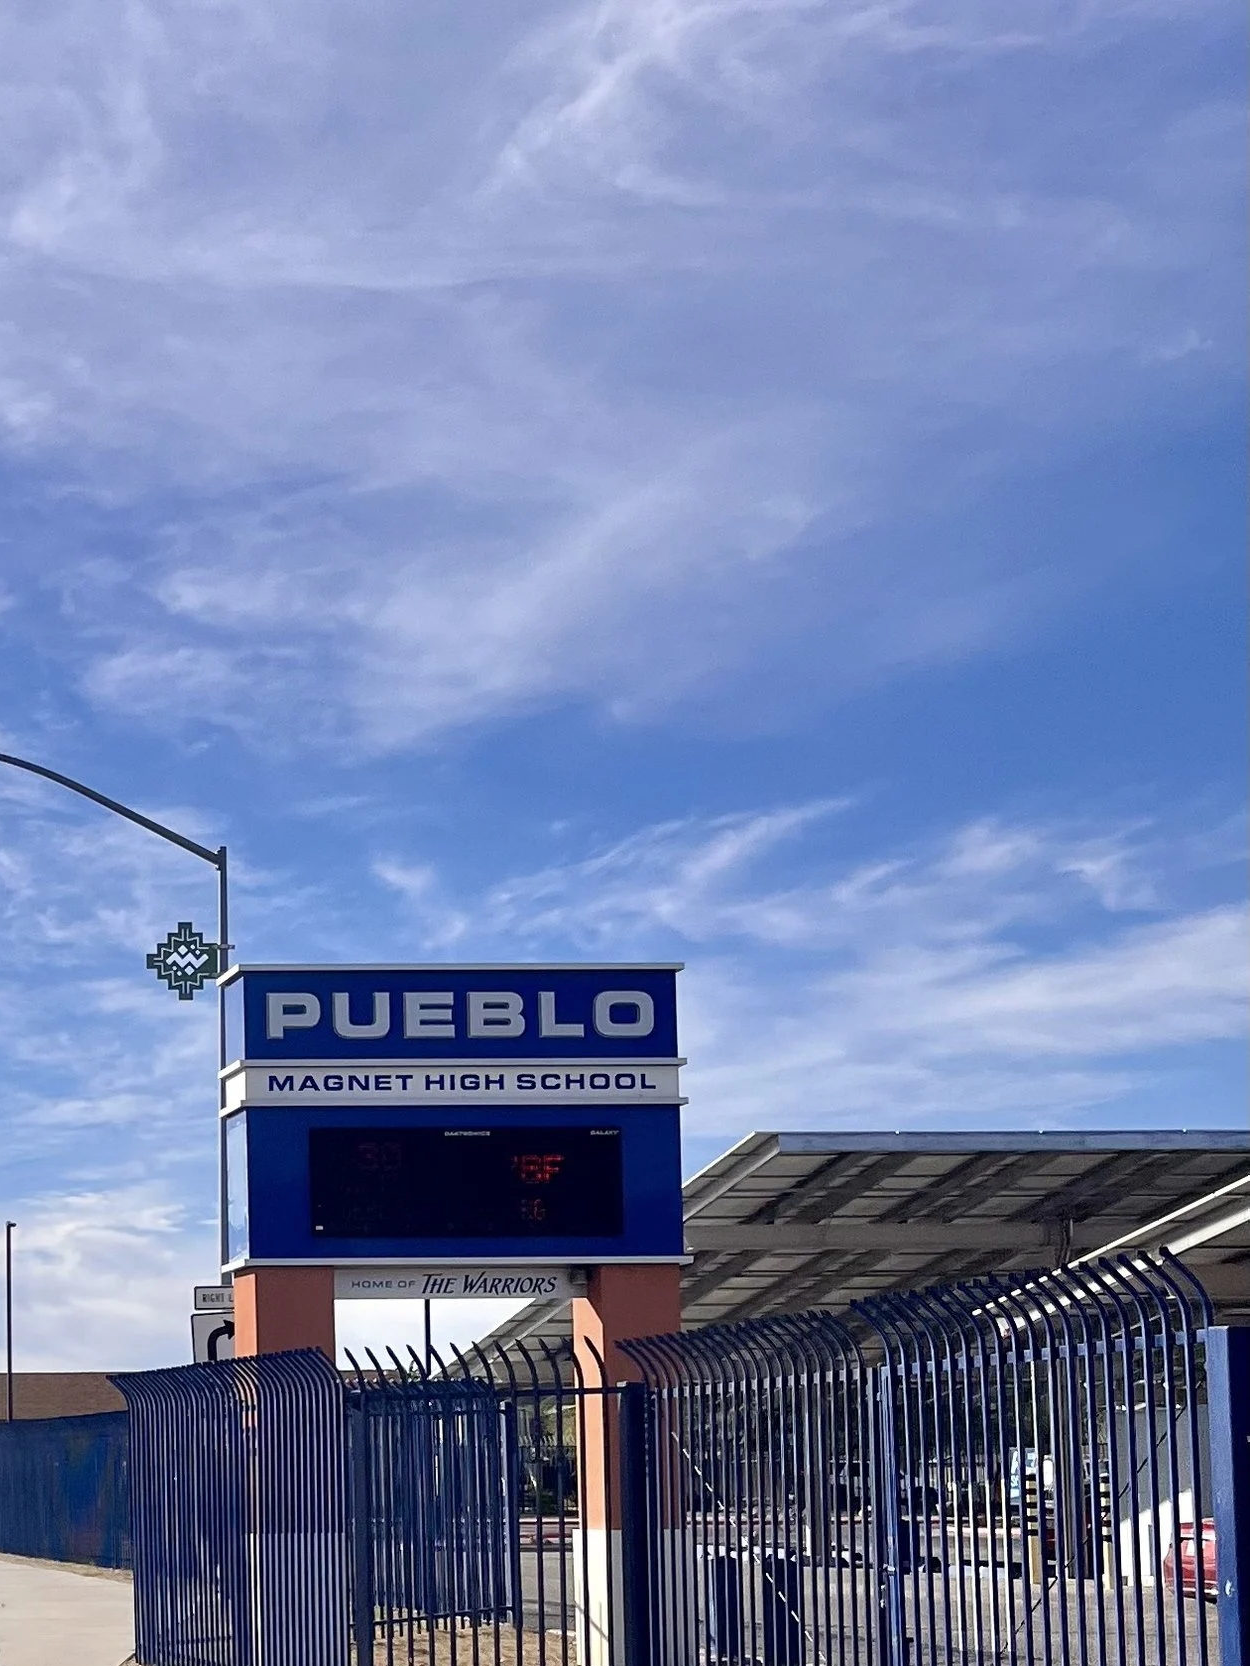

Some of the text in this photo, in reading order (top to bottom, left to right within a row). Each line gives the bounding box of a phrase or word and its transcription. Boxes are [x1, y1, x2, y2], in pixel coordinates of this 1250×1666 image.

[266, 990, 654, 1039] PUEBLO
[268, 1073, 656, 1092] MAGNET HIGH SCHOOL
[352, 1271, 558, 1296] HOME OF THE WARRIORS
[202, 1293, 225, 1303] RIGHT
